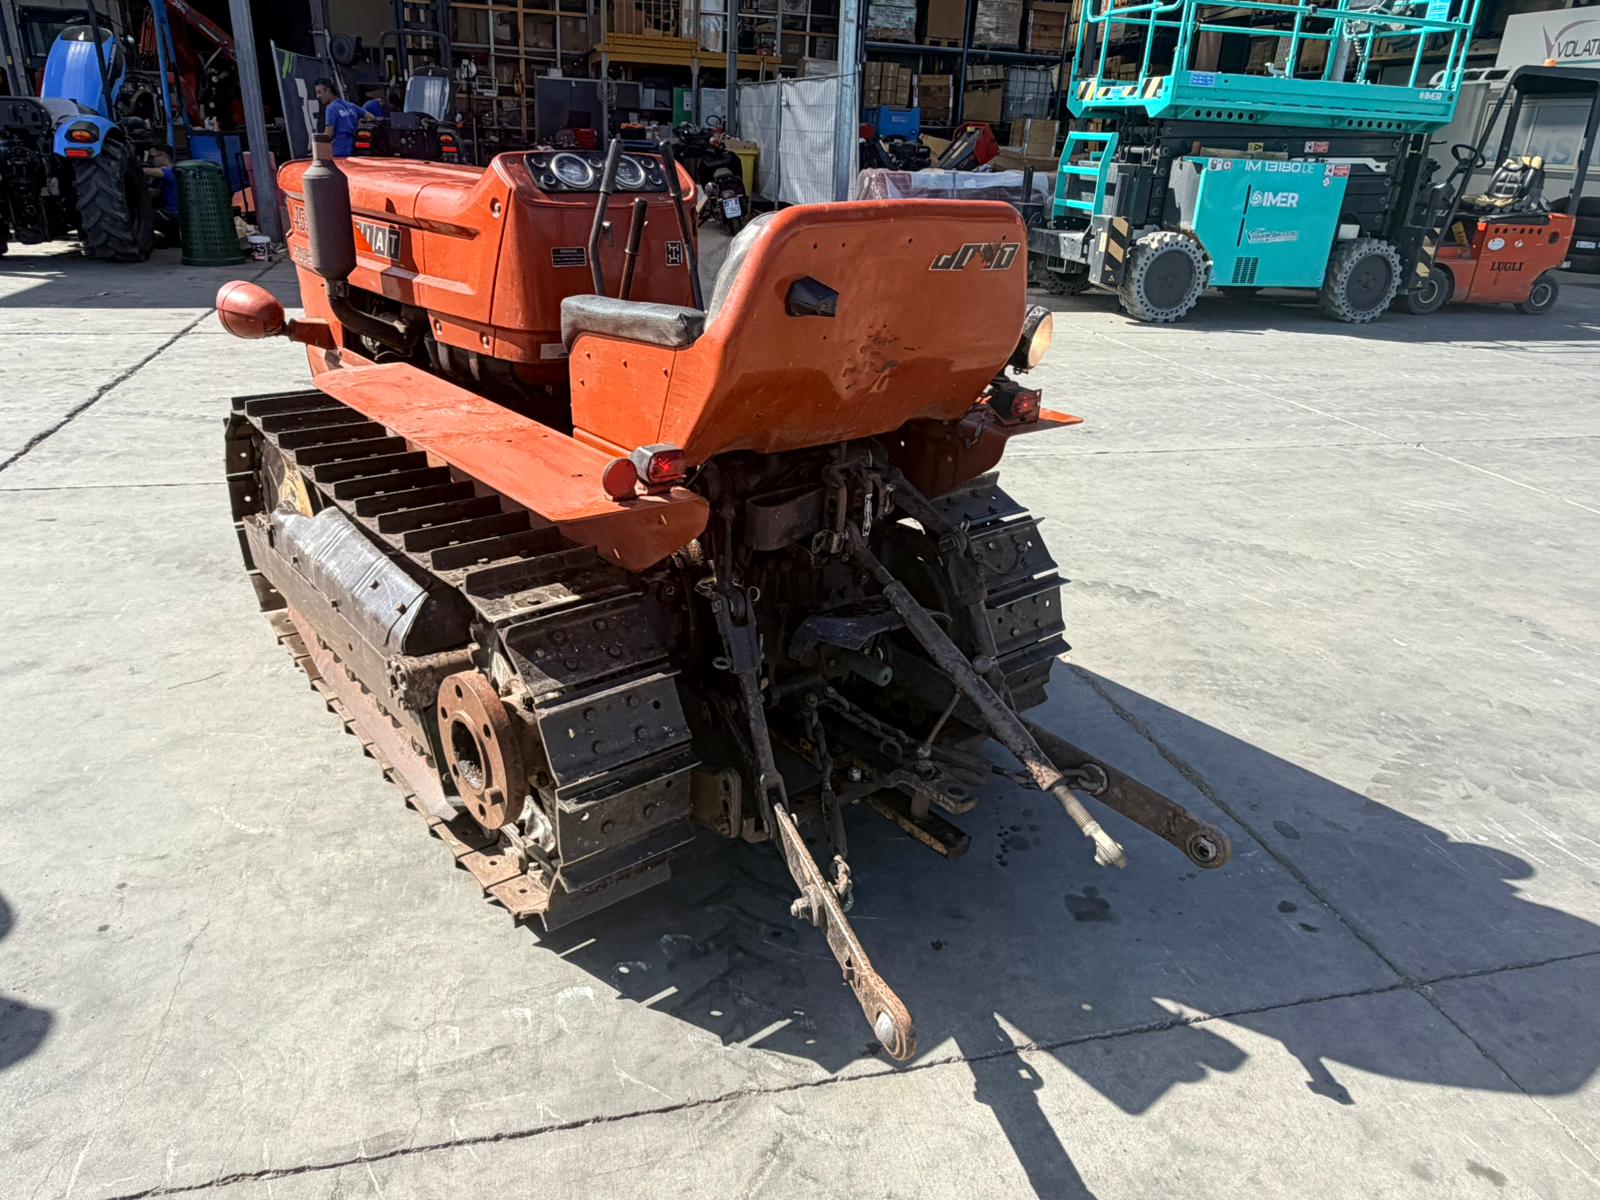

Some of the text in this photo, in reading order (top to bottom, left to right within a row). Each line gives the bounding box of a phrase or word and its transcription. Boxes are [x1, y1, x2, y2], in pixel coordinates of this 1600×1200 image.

[1245, 161, 1262, 171] IM
[1262, 191, 1299, 207] IMER
[1490, 261, 1524, 272] LUGLI
